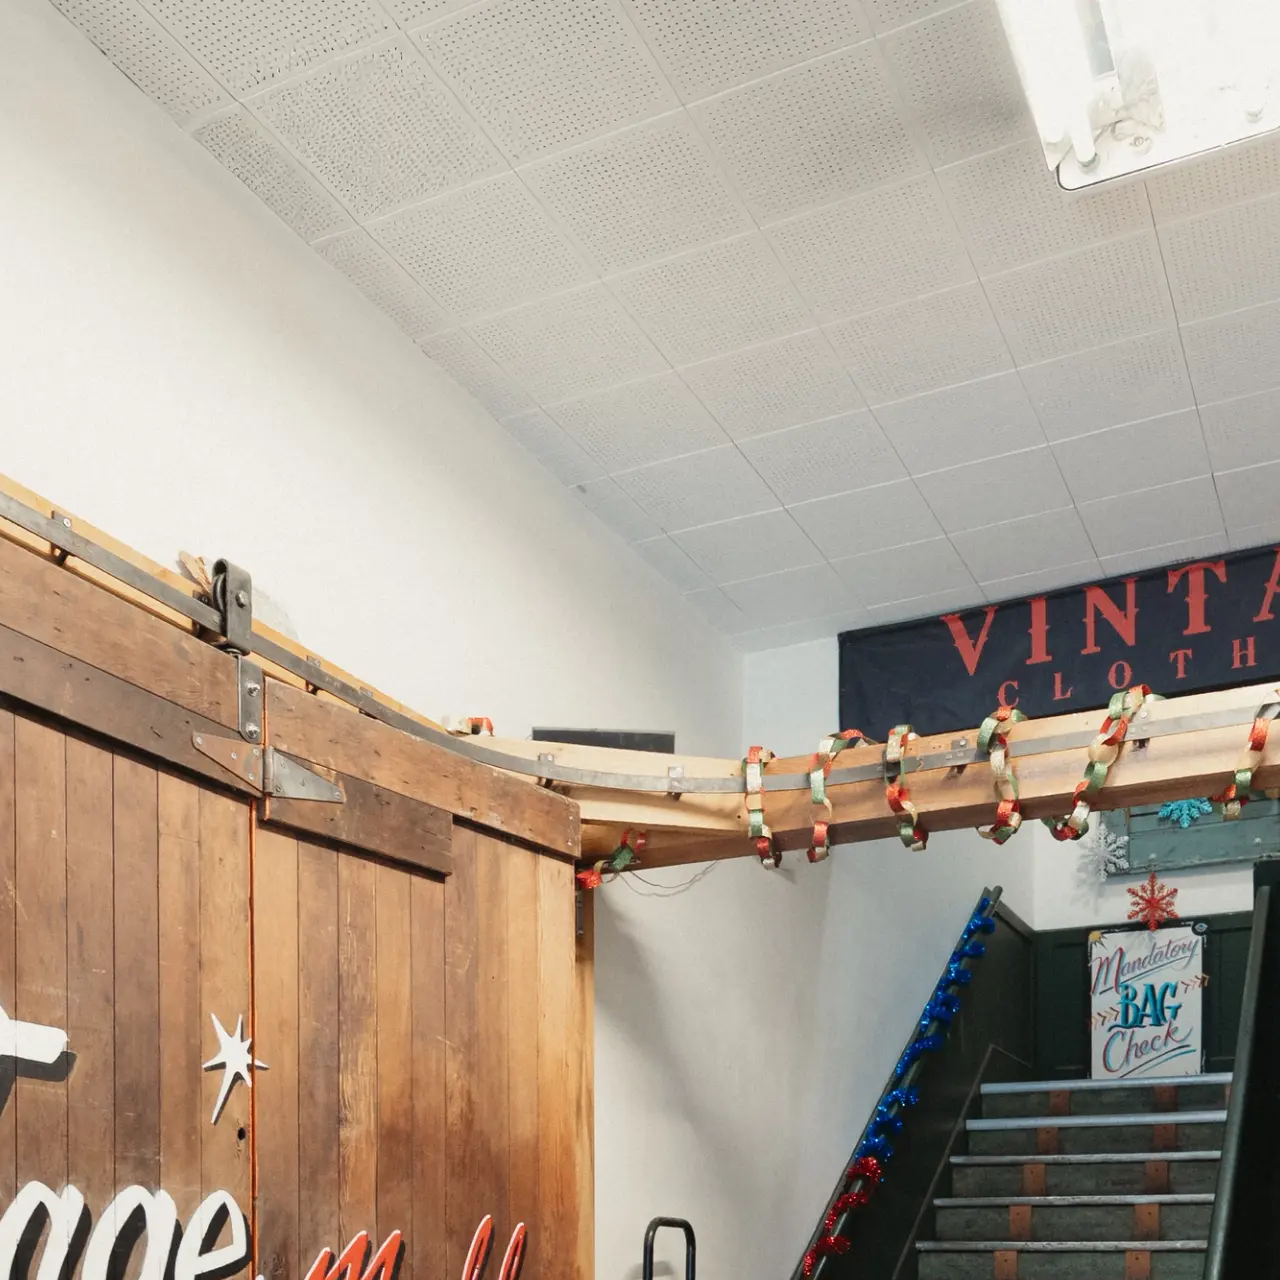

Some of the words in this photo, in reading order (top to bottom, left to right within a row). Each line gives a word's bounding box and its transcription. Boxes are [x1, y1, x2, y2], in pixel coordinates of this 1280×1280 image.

[1089, 937, 1201, 997] Mandatory
[1117, 981, 1182, 1027] BAG
[1102, 1019, 1194, 1074] Check
